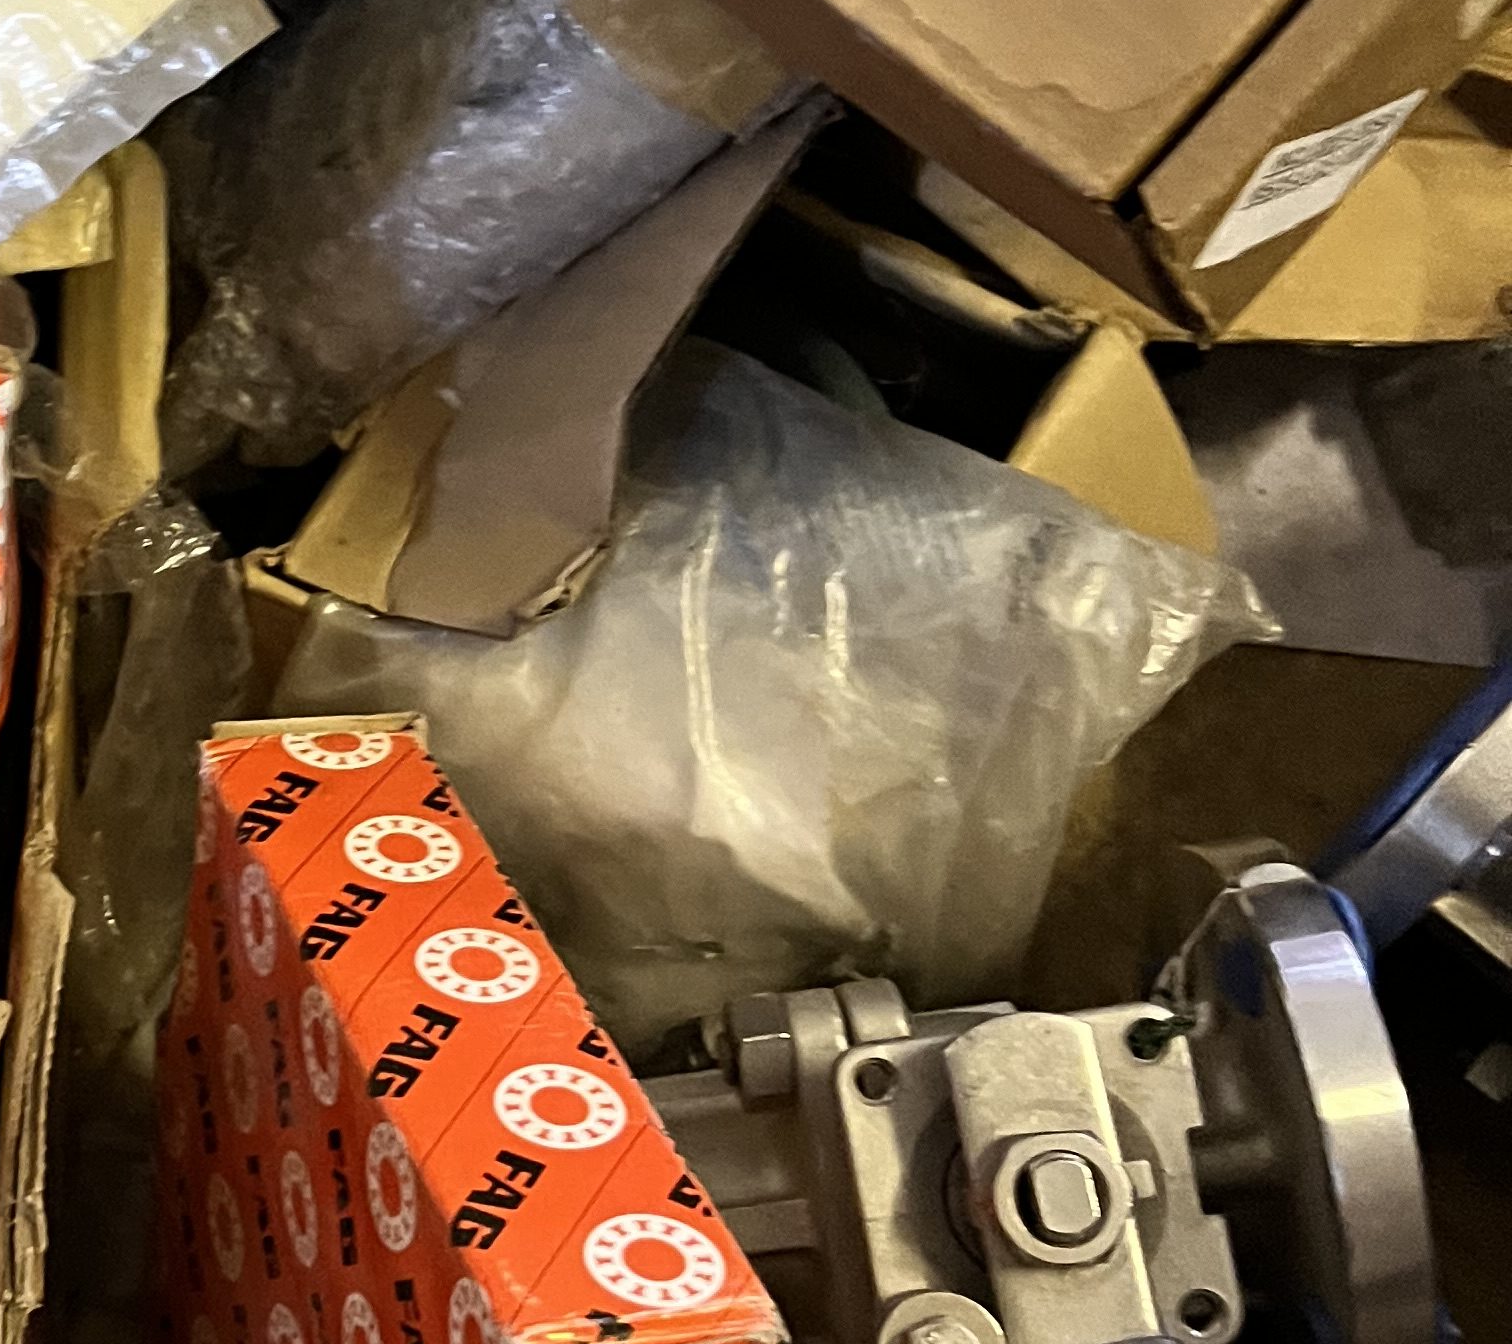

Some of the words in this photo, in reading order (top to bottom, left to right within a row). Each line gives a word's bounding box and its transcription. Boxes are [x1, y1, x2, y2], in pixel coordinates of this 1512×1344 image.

[237, 770, 320, 845] FAG
[299, 882, 388, 962] FAG
[367, 1003, 462, 1100] FAG
[450, 1149, 547, 1252] FAG
